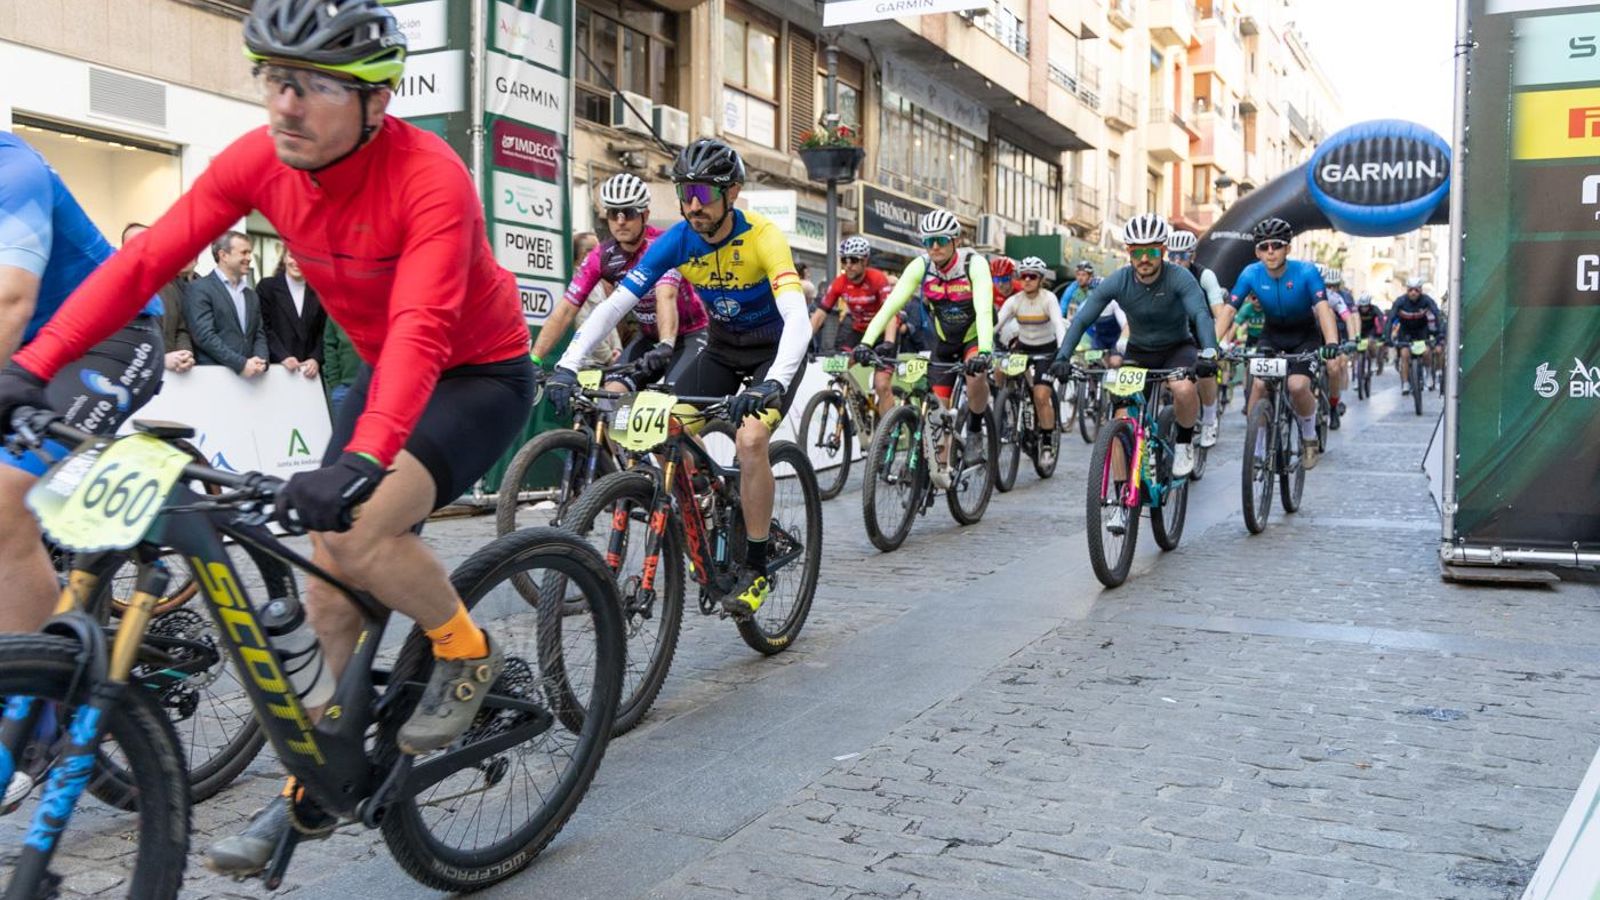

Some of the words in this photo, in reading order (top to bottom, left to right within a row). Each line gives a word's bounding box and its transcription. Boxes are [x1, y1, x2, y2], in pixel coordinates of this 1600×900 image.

[496, 77, 559, 110] GARMIN
[515, 136, 556, 161] IMDECO
[1321, 159, 1437, 183] GARMIN
[505, 232, 553, 254] POWER
[1210, 231, 1255, 241] garmin.co
[527, 252, 554, 270] ADE
[1119, 371, 1143, 385] 639
[1256, 360, 1279, 373] 55-1
[75, 400, 113, 434] ierra
[632, 407, 666, 434] 674
[83, 462, 159, 527] 660
[191, 556, 326, 766] SCOTT
